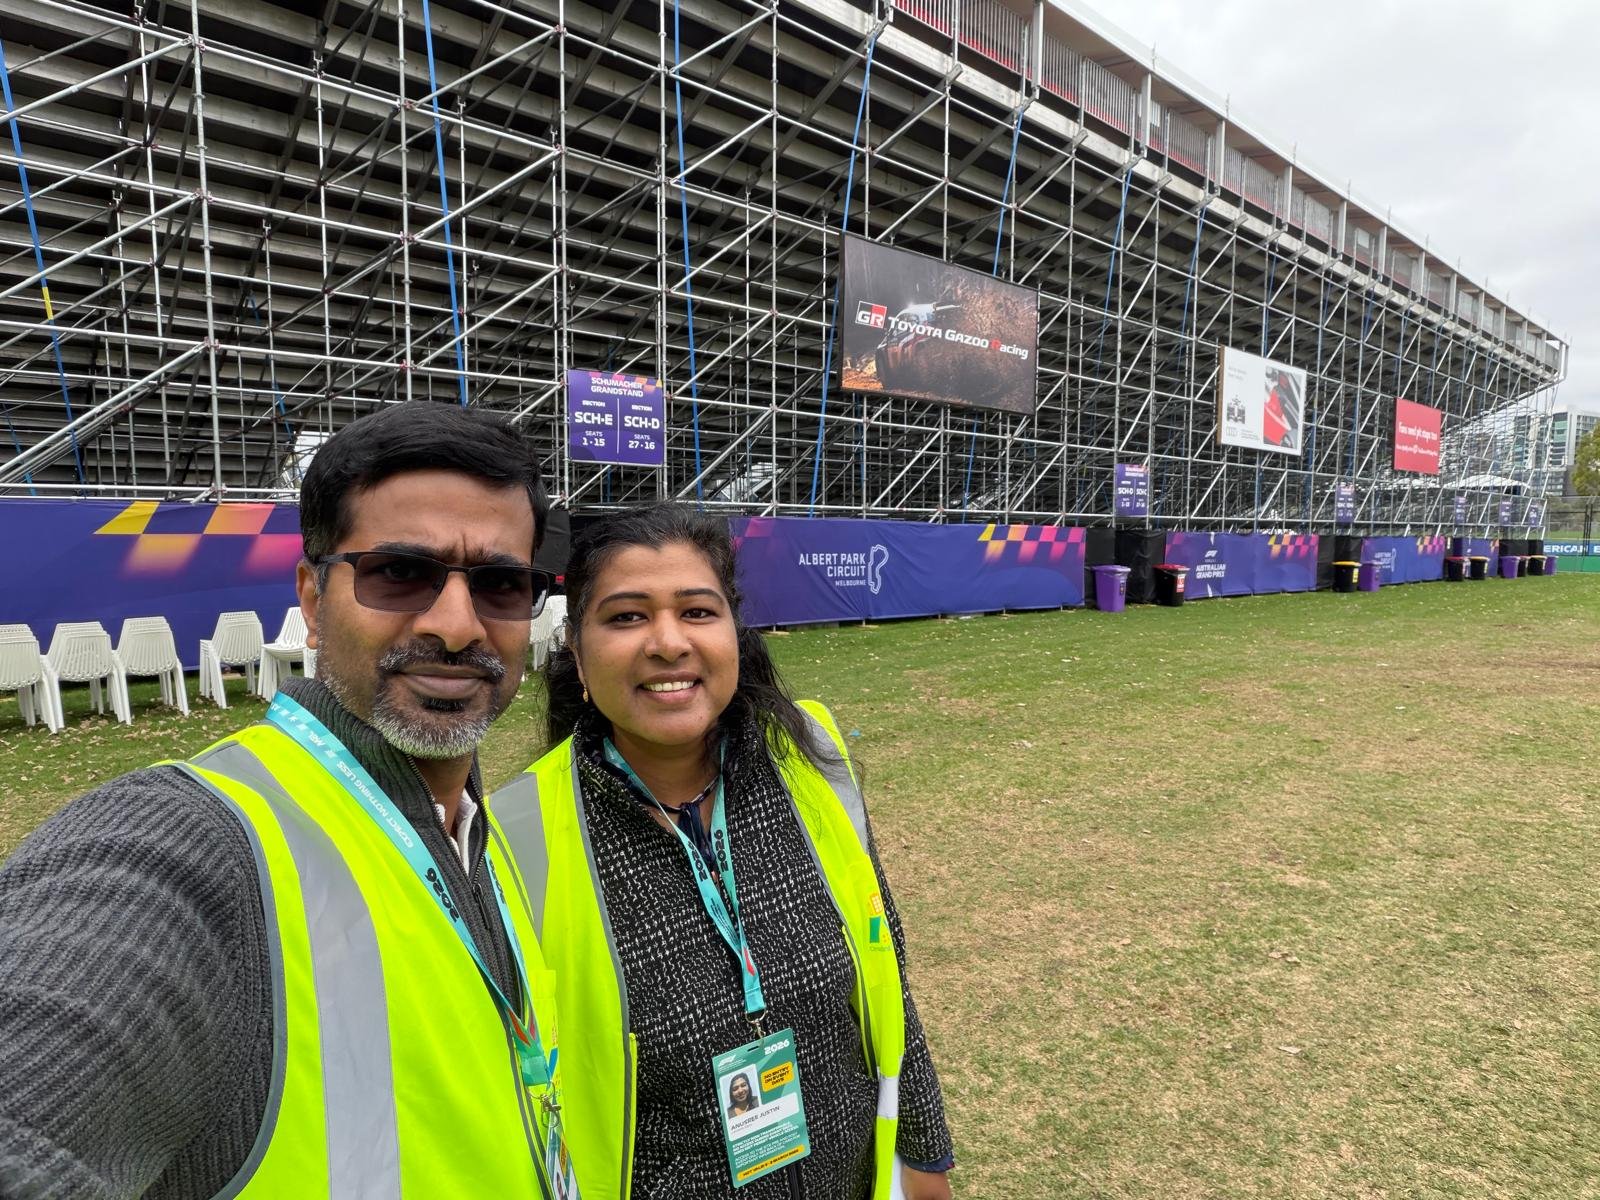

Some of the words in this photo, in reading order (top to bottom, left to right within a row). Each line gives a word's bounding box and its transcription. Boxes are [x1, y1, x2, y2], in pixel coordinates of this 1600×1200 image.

[857, 310, 883, 328] GR
[888, 316, 942, 338] TOYOTA
[945, 329, 989, 348] GAZOO
[991, 338, 1029, 360] Racing
[591, 377, 642, 389] SCHUMACHER
[591, 385, 643, 397] GRANDSTAND
[574, 412, 613, 425] SCH-E
[624, 416, 660, 429] SCH-D
[799, 553, 838, 565] ALBERT
[840, 553, 866, 565] PARK
[827, 566, 866, 577] CIRCUIT
[337, 761, 357, 781] LESS
[355, 780, 388, 820] NOTHING
[387, 817, 413, 848] EXPECT
[714, 829, 729, 873] 2026
[425, 867, 460, 923] 2026
[764, 1039, 790, 1055] 2026
[732, 1115, 758, 1130] ANUSREE
[760, 1106, 779, 1117] JUSTIN
